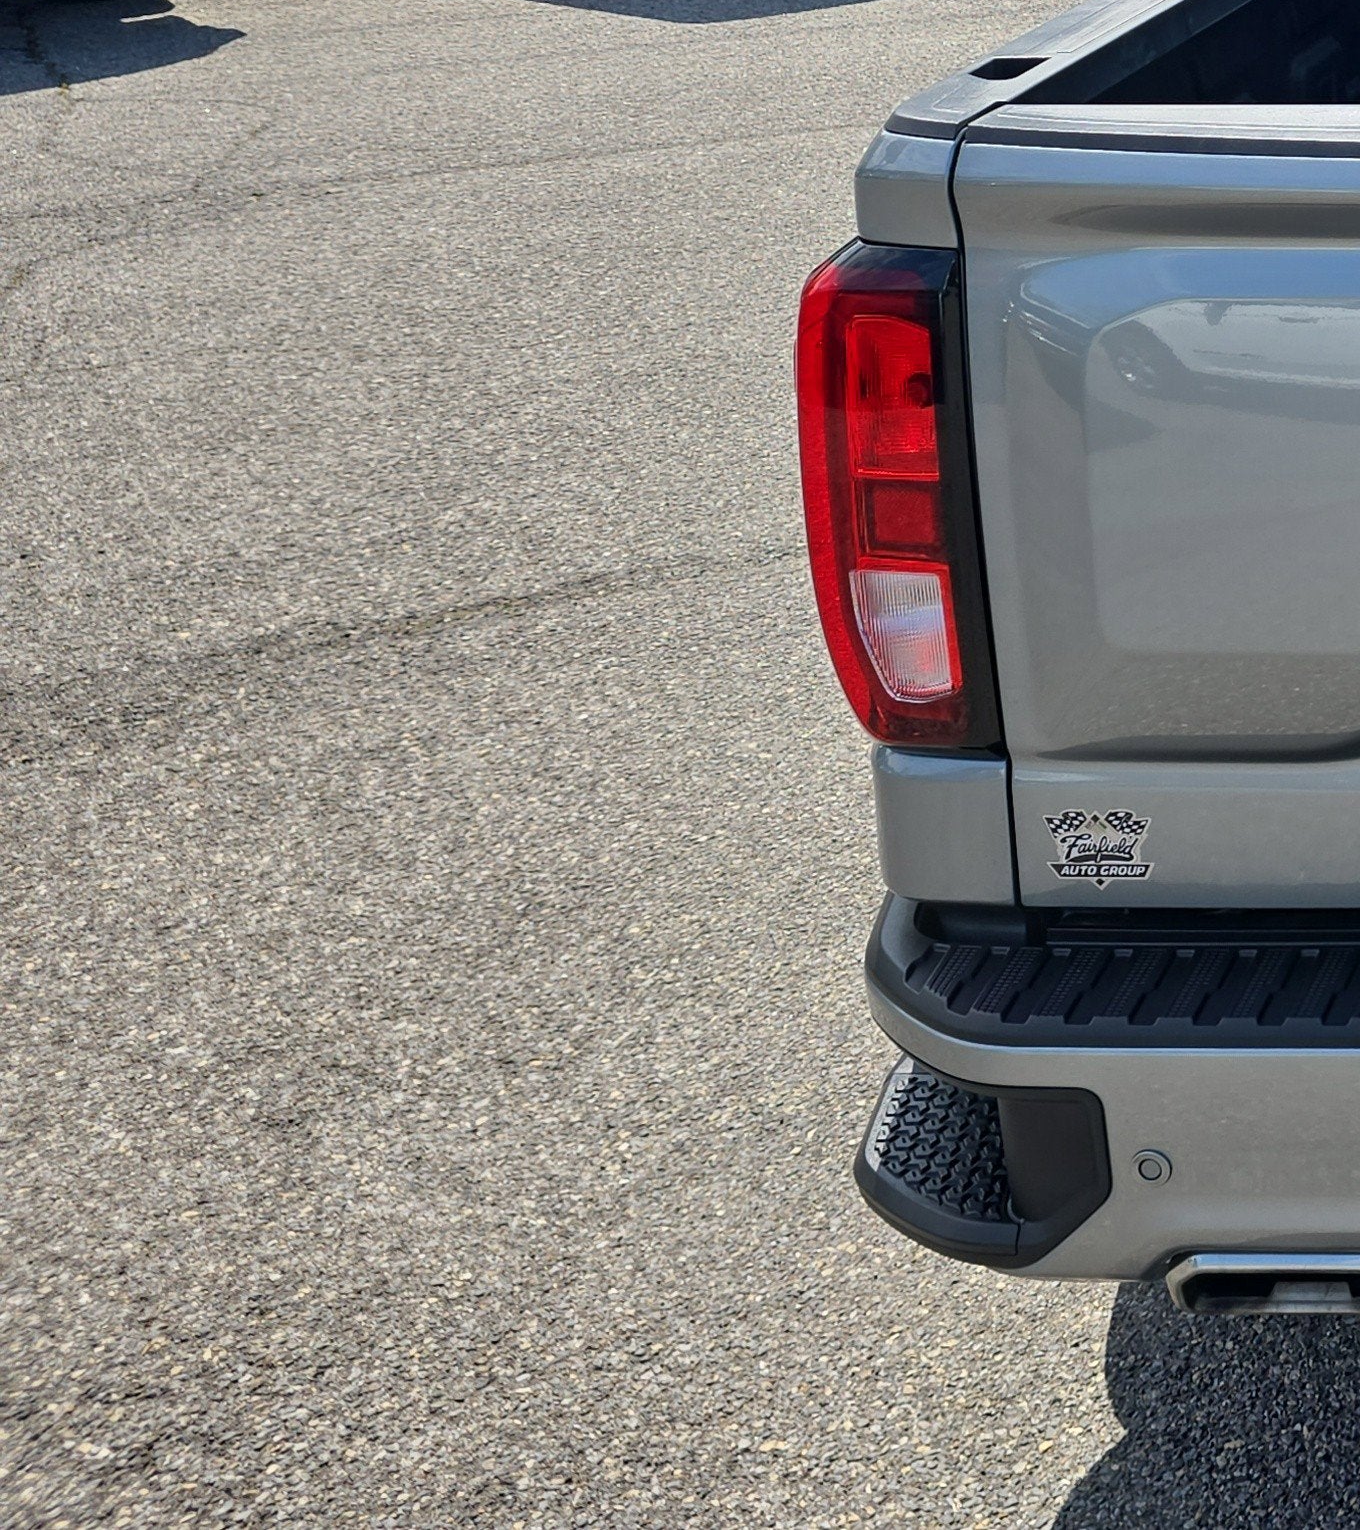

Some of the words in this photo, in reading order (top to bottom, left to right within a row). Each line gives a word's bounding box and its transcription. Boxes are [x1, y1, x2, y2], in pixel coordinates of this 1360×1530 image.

[1060, 832, 1139, 862] Fairfield
[1061, 865, 1097, 876] AUTO
[1099, 865, 1146, 876] GROUP
